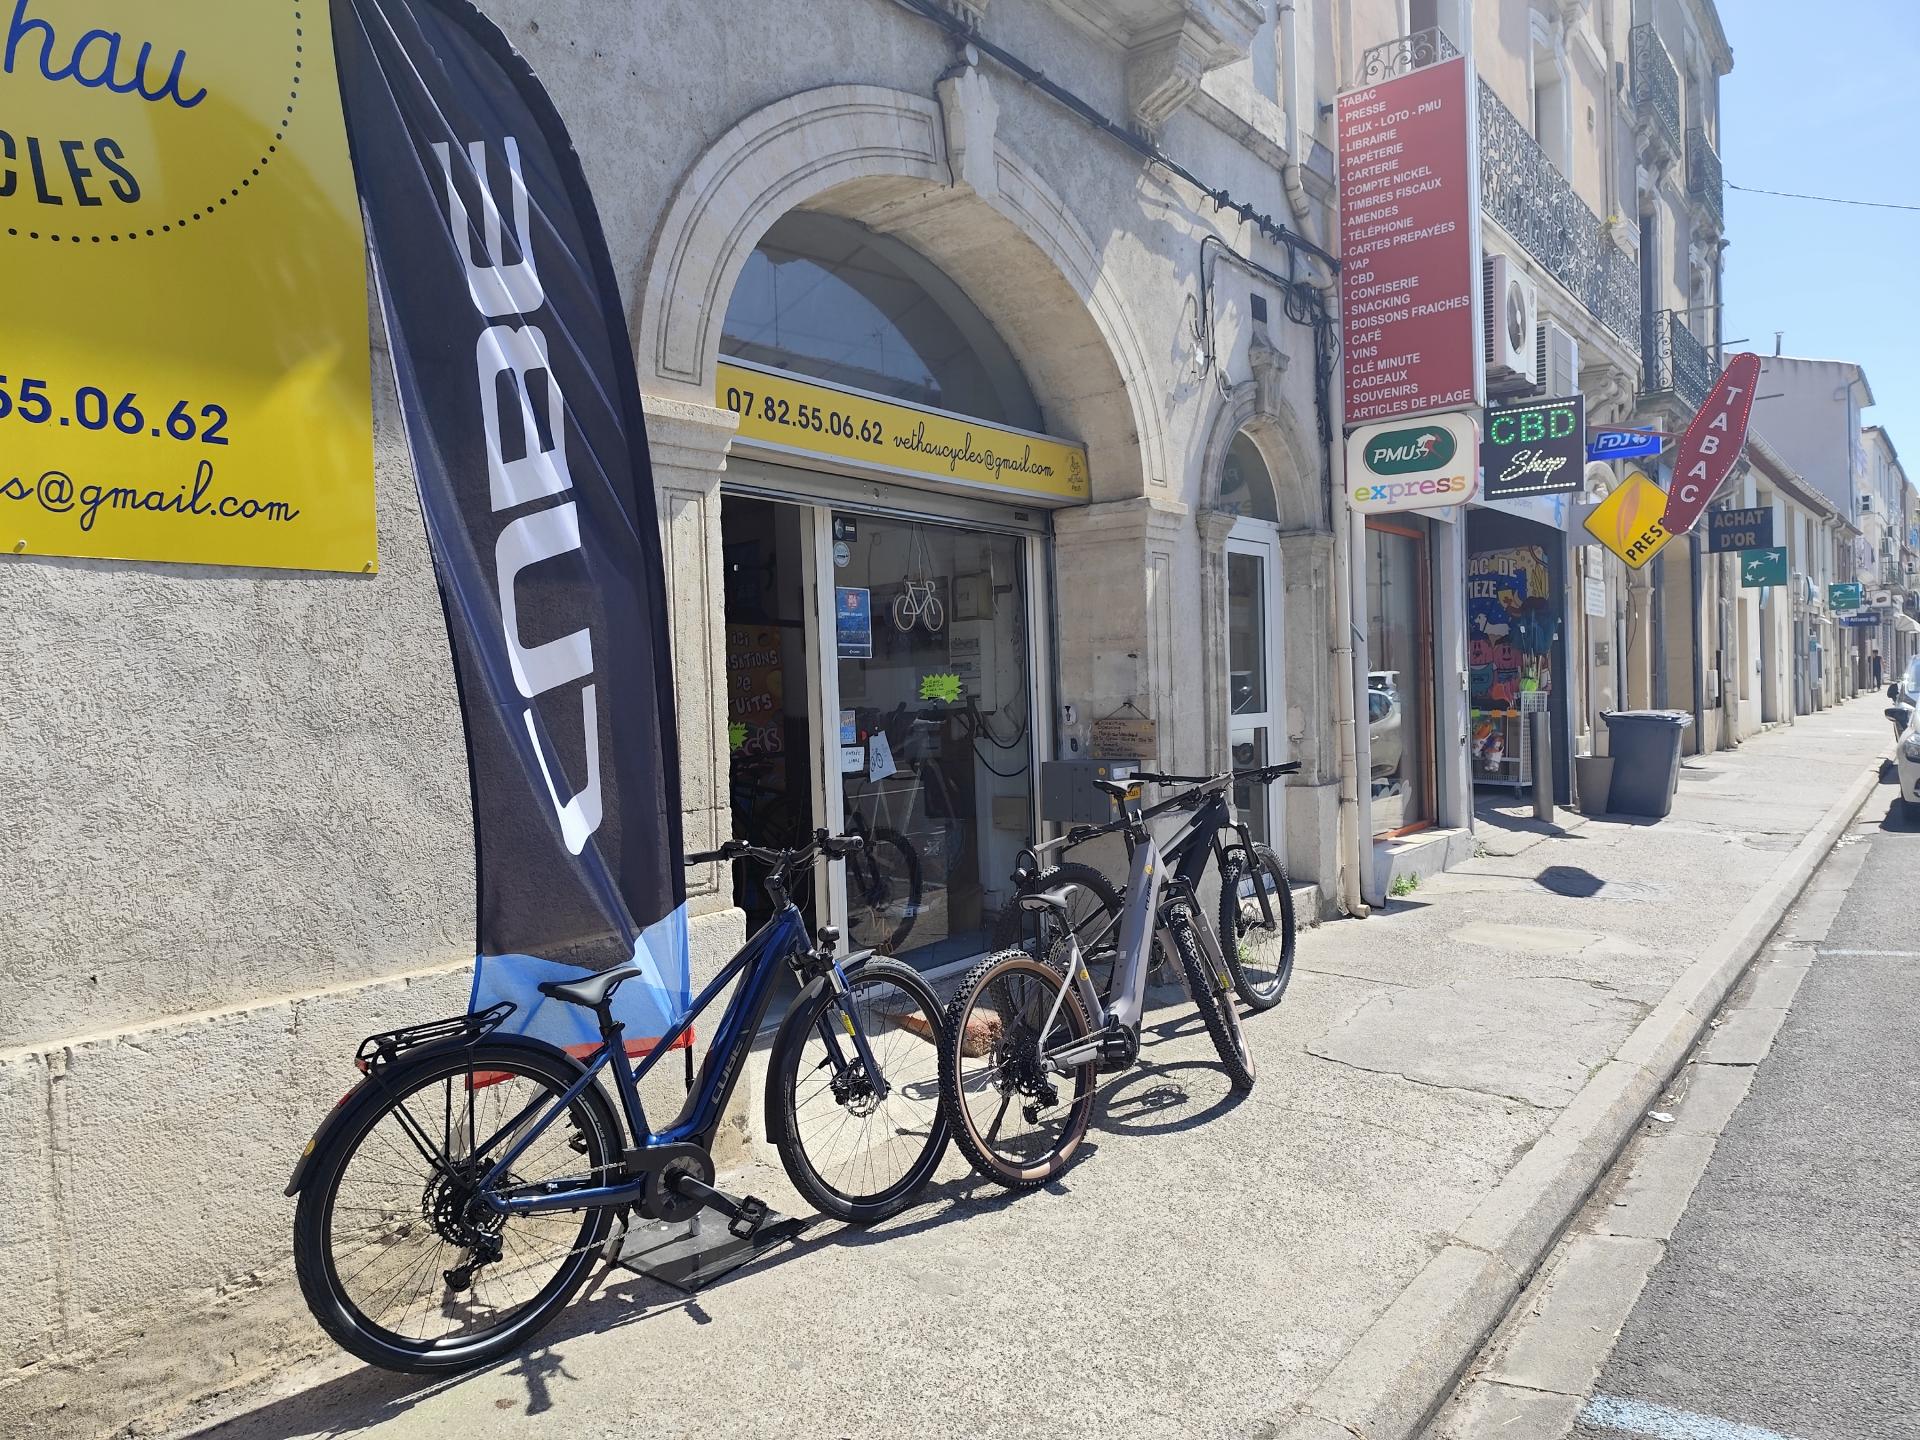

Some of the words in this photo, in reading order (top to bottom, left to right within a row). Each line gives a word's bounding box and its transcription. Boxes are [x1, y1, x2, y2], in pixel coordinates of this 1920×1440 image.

[1345, 101, 1387, 122] PRESSE
[1346, 121, 1373, 138] JEUX
[1381, 110, 1410, 126] LOTO
[1418, 99, 1442, 115] PMU
[1346, 128, 1398, 152] LIBRAIRIE
[1347, 158, 1399, 182] CARTERIE
[1348, 178, 1391, 197] COMPTE
[1394, 166, 1432, 184] NICKEL
[1348, 192, 1394, 212] TIMBRES
[1396, 178, 1442, 200] FISCAUX
[1348, 205, 1399, 227] AMENDES
[1350, 238, 1391, 257] CARTES
[1349, 258, 1370, 271] VAP
[1350, 272, 1375, 286] CBD
[1350, 276, 1420, 301] CONFISERIE
[1351, 293, 1411, 316] SNACKING
[1351, 309, 1409, 331] BOISSONS
[1412, 295, 1470, 318] FRAICHES
[1352, 328, 1382, 346] CAFÉ
[1352, 346, 1378, 360] VINS
[1352, 360, 1375, 375] CLÉ
[1378, 352, 1421, 371] MINUTE
[1352, 369, 1408, 390] CADEAUX
[1352, 400, 1408, 420] ARTICLES
[1411, 396, 1428, 409] DE
[1430, 388, 1472, 406] PLAGE
[1353, 383, 1419, 405] SOUVENIRS
[726, 387, 883, 445] 07.82.55.06.62
[893, 421, 1054, 480] vethaucycles@gmail.com
[1491, 408, 1576, 445] CBD
[1599, 432, 1632, 449] FDJ
[1680, 386, 1743, 503] TABAC
[1373, 442, 1416, 465] PMU
[1500, 449, 1568, 484] Shop
[431, 135, 603, 856] CUBE
[1354, 474, 1467, 504] express
[1714, 510, 1764, 528] ACHAT
[1721, 532, 1756, 548] D'OR
[1498, 559, 1517, 578] DE
